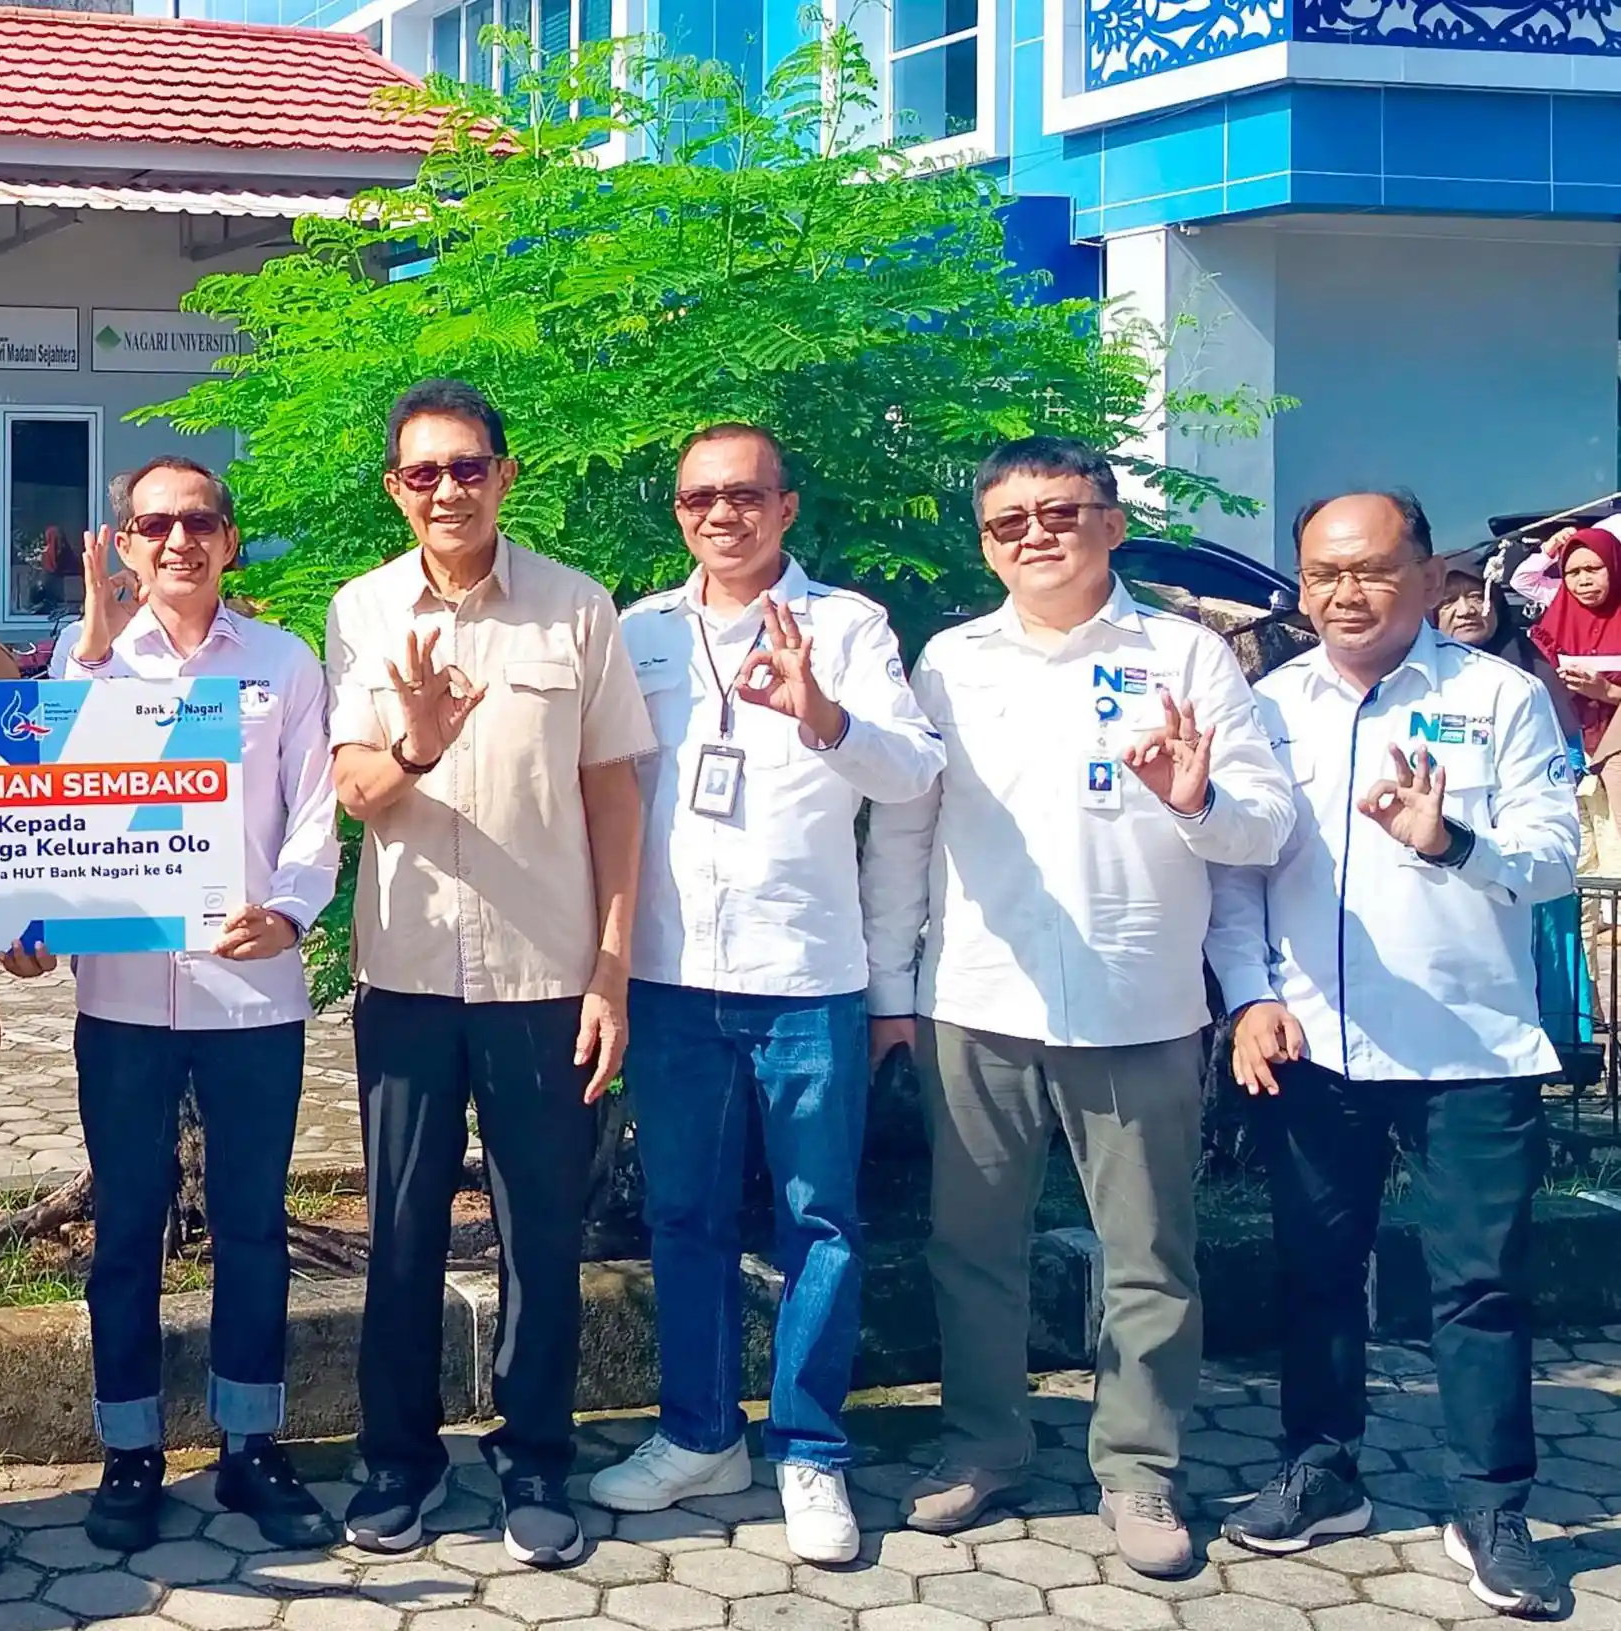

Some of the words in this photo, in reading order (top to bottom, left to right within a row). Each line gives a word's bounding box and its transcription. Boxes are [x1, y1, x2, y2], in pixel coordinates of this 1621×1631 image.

[124, 331, 168, 351] NAGARI
[171, 333, 237, 352] UNIVERSITY
[7, 343, 37, 362] Madani
[38, 344, 77, 367] Sejahtera
[136, 704, 166, 715] Bank
[184, 702, 223, 716] Nagari
[62, 769, 220, 798] SEMBAKO
[36, 836, 159, 857] Kelurahan
[168, 835, 210, 852] Olo
[13, 867, 45, 879] HUT
[50, 866, 86, 878] Bank
[91, 864, 139, 879] Nagari
[144, 864, 161, 876] ke
[165, 864, 183, 875] 64
